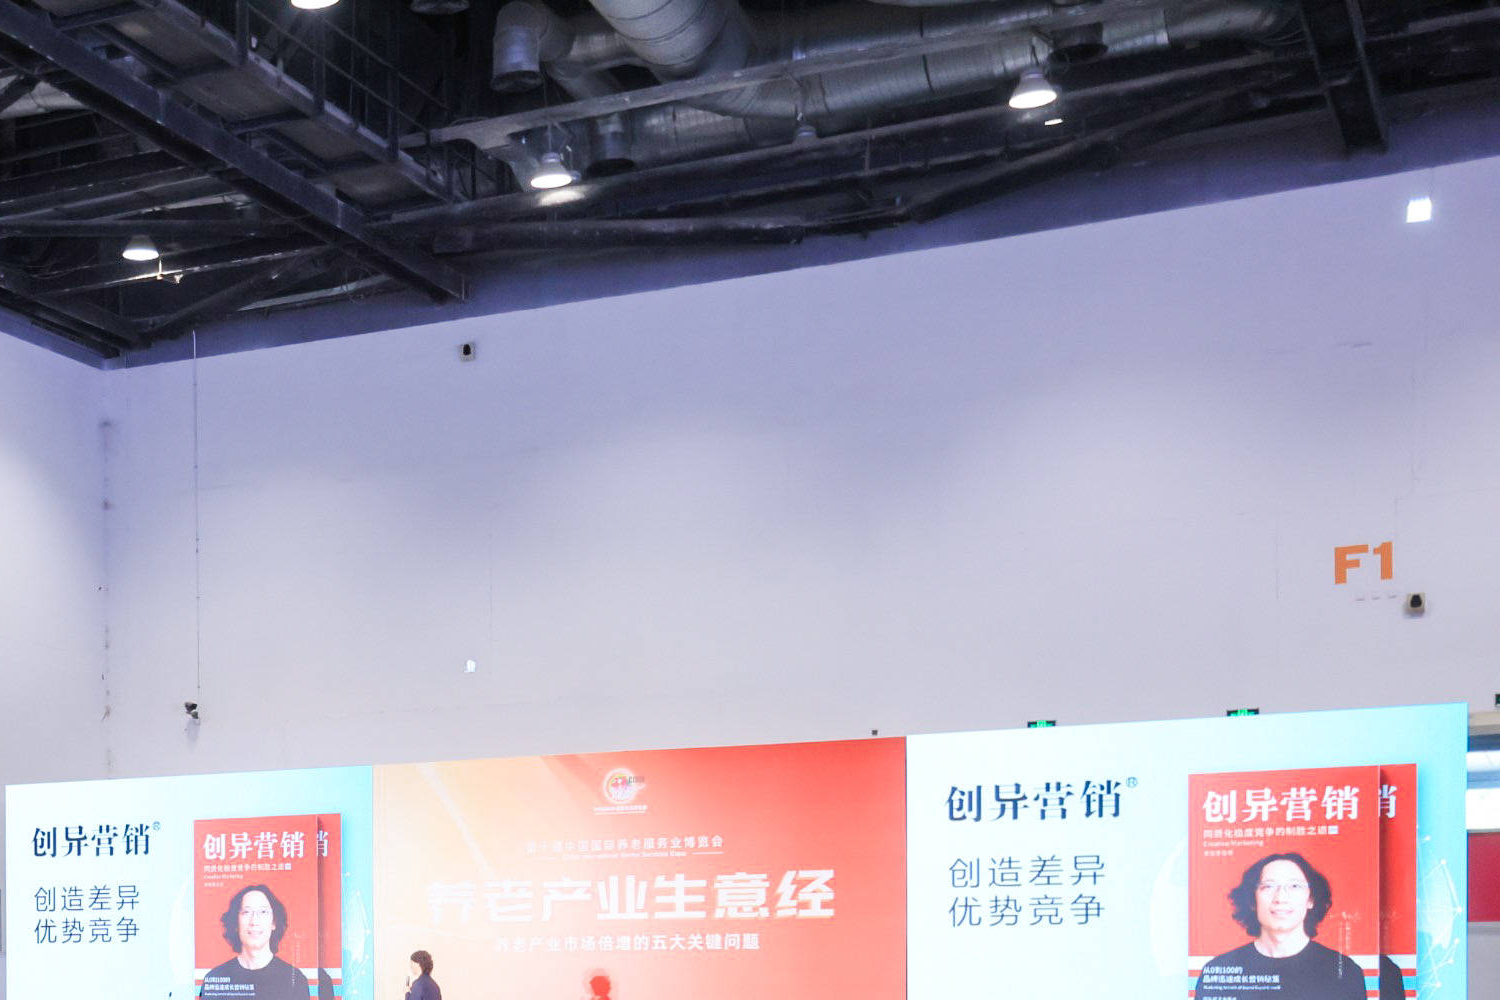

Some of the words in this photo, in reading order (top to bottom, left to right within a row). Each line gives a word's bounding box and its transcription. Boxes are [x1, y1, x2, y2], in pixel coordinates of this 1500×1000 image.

[1334, 541, 1393, 584] F1
[1202, 785, 1359, 823] 创异营销
[203, 831, 304, 860] 创异营销
[948, 855, 1105, 888] 创造差异
[34, 885, 139, 912] 创造差异
[426, 869, 835, 924] 养老产业生意经
[948, 894, 1106, 928] 优势竞争
[34, 916, 140, 944] 优势竞争
[495, 933, 760, 953] 养老产业市场倍增的五大关键问题
